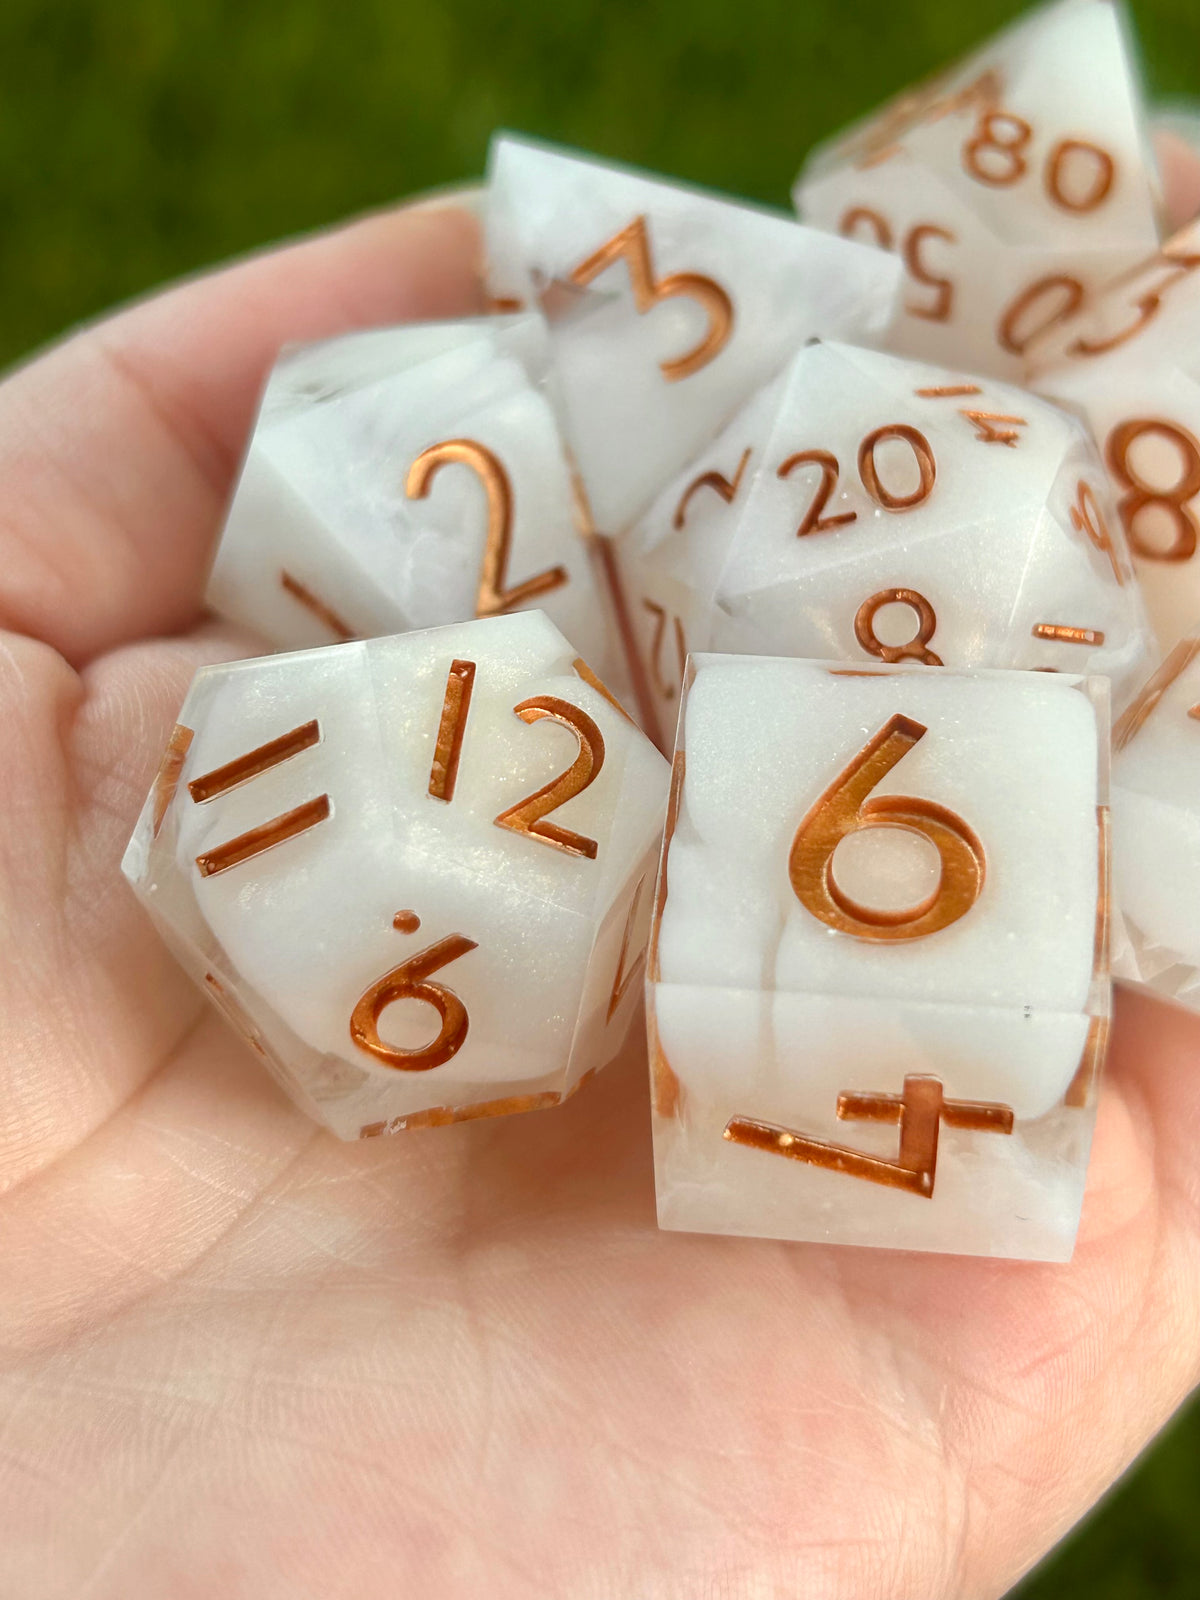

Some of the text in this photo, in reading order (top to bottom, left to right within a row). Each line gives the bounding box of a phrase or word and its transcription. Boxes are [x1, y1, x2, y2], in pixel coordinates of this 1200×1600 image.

[961, 112, 1117, 214] 80
[567, 213, 735, 384] 3
[405, 438, 568, 618] 2
[777, 424, 936, 539] 20
[1105, 418, 1200, 564] 8
[427, 659, 606, 861] 12
[789, 713, 986, 944] 6
[723, 1073, 1015, 1200] 4
